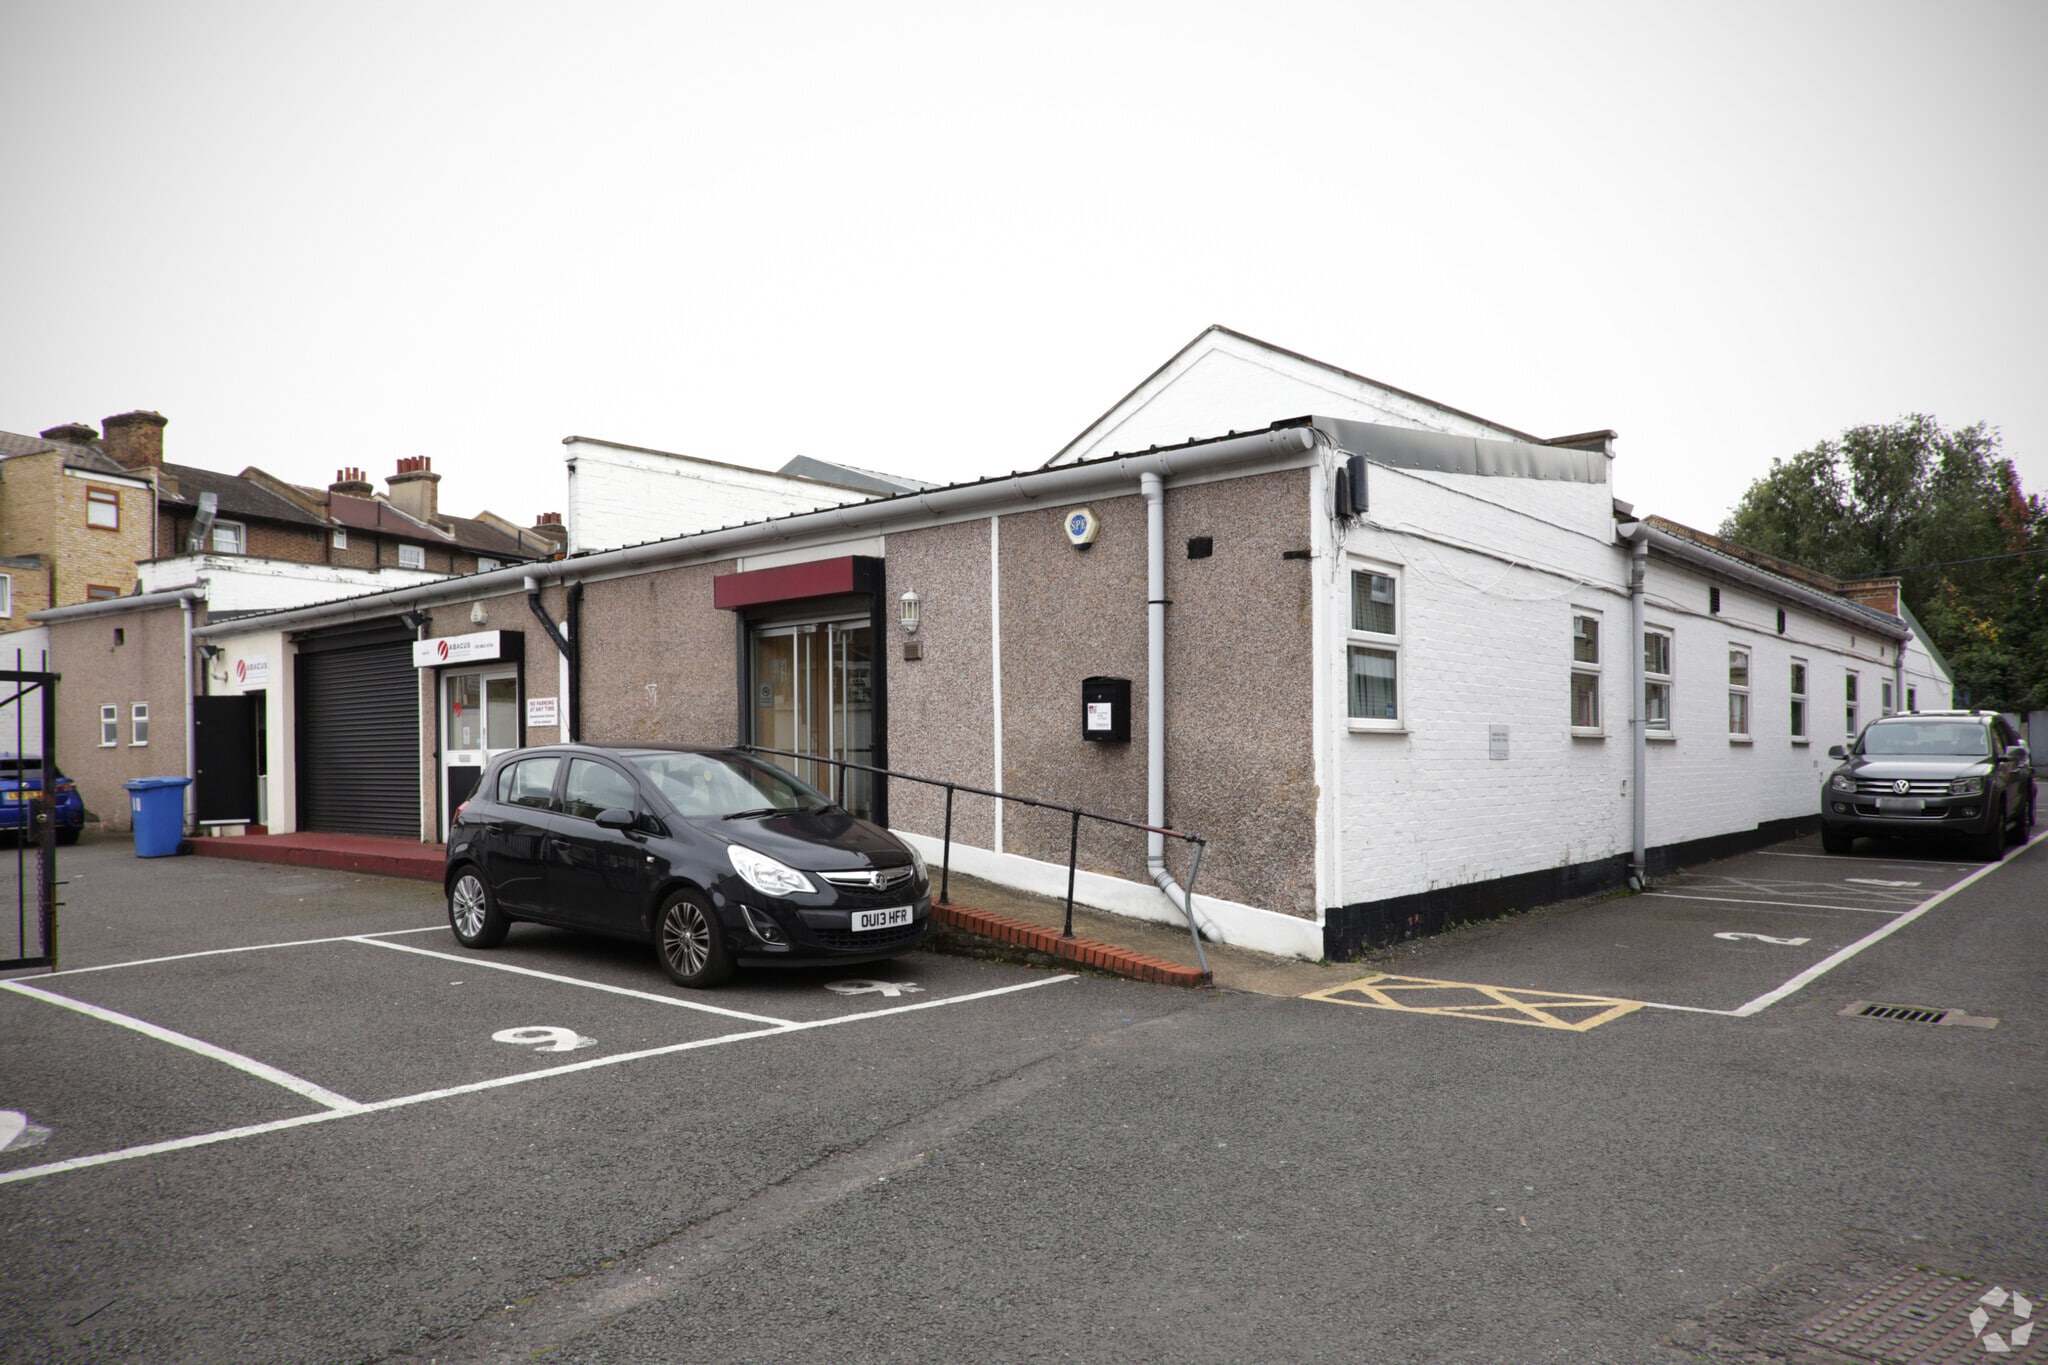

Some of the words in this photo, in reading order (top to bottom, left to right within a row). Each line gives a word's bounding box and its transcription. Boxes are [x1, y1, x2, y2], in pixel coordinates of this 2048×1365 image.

[449, 642, 471, 651] ABACUS
[247, 661, 268, 671] ABACUS
[861, 911, 886, 928] OU13
[889, 909, 907, 925] HFR
